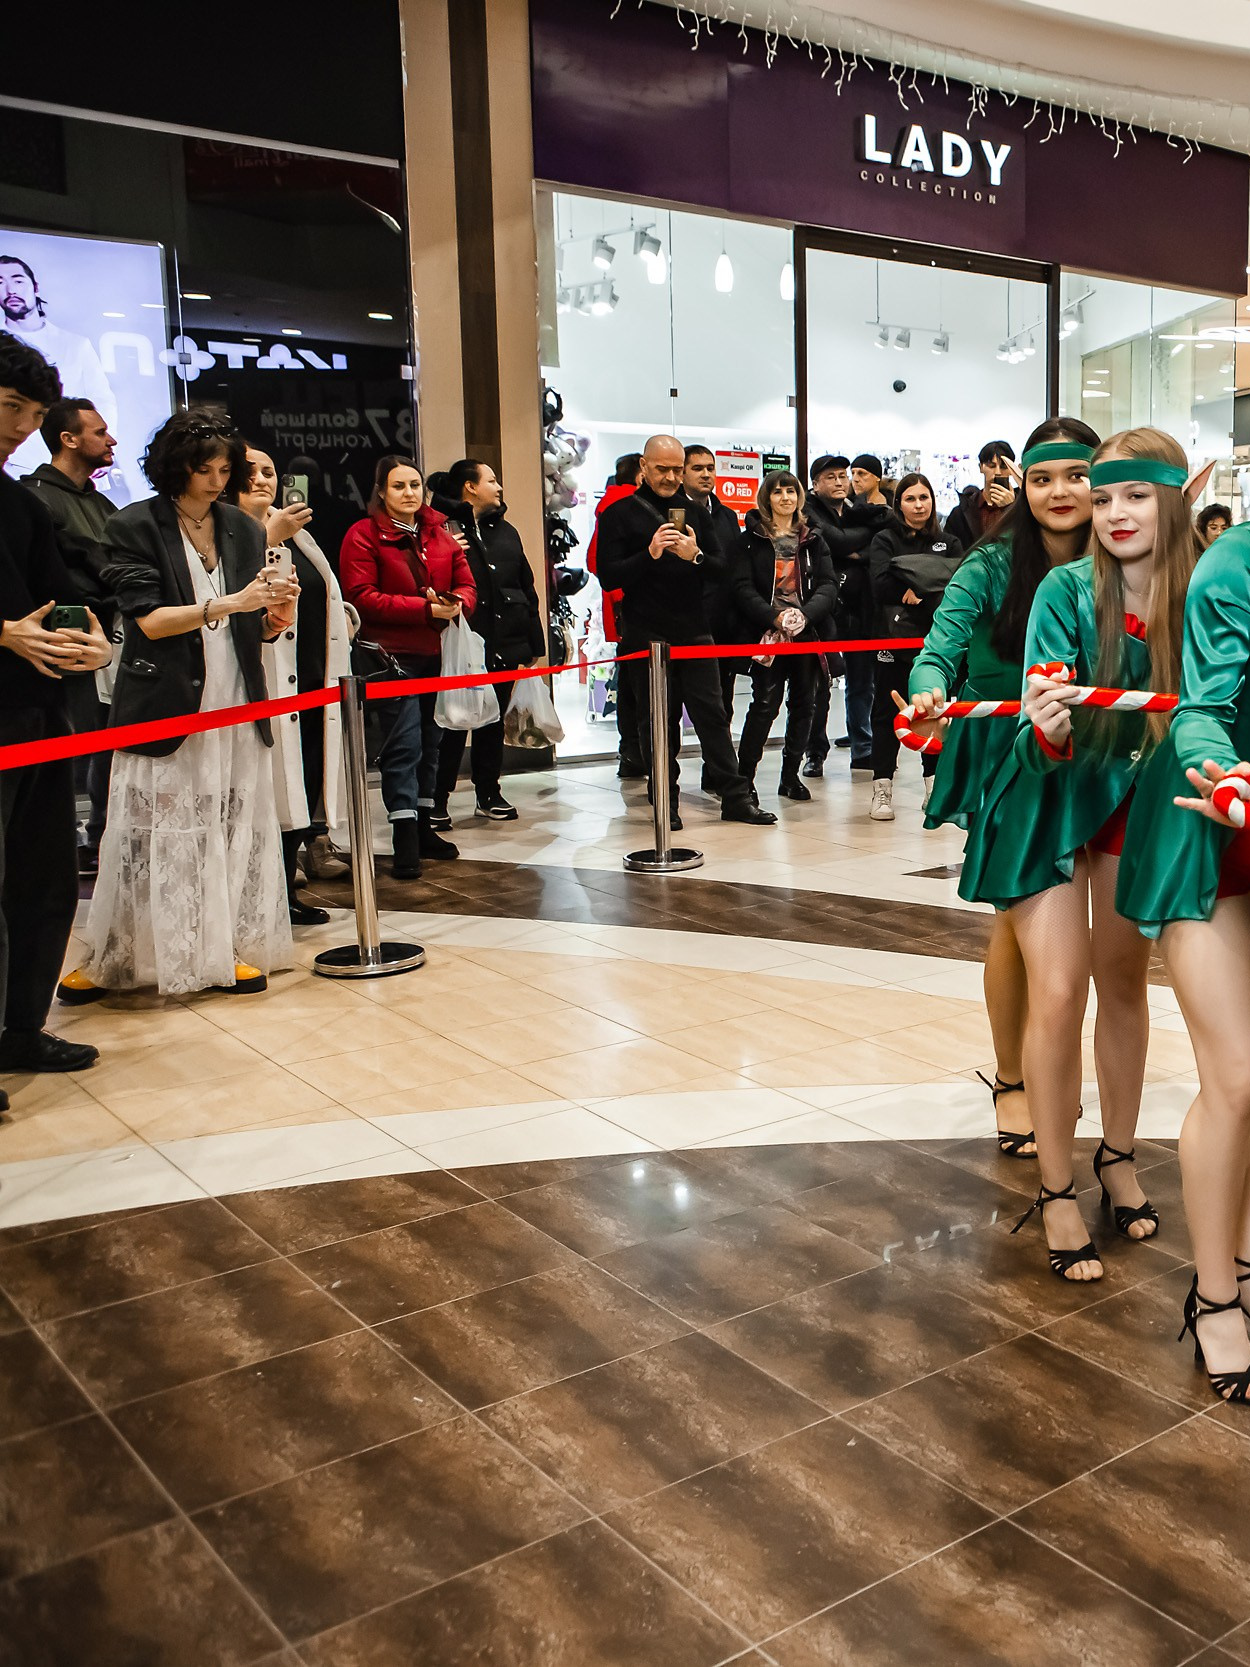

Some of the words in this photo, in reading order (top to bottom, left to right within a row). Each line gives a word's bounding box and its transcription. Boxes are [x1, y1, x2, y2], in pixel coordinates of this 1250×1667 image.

[864, 113, 1012, 186] LADY
[859, 170, 996, 204] COLLECTION
[730, 463, 745, 471] Kaspi
[746, 463, 754, 471] QR
[736, 488, 752, 497] RED
